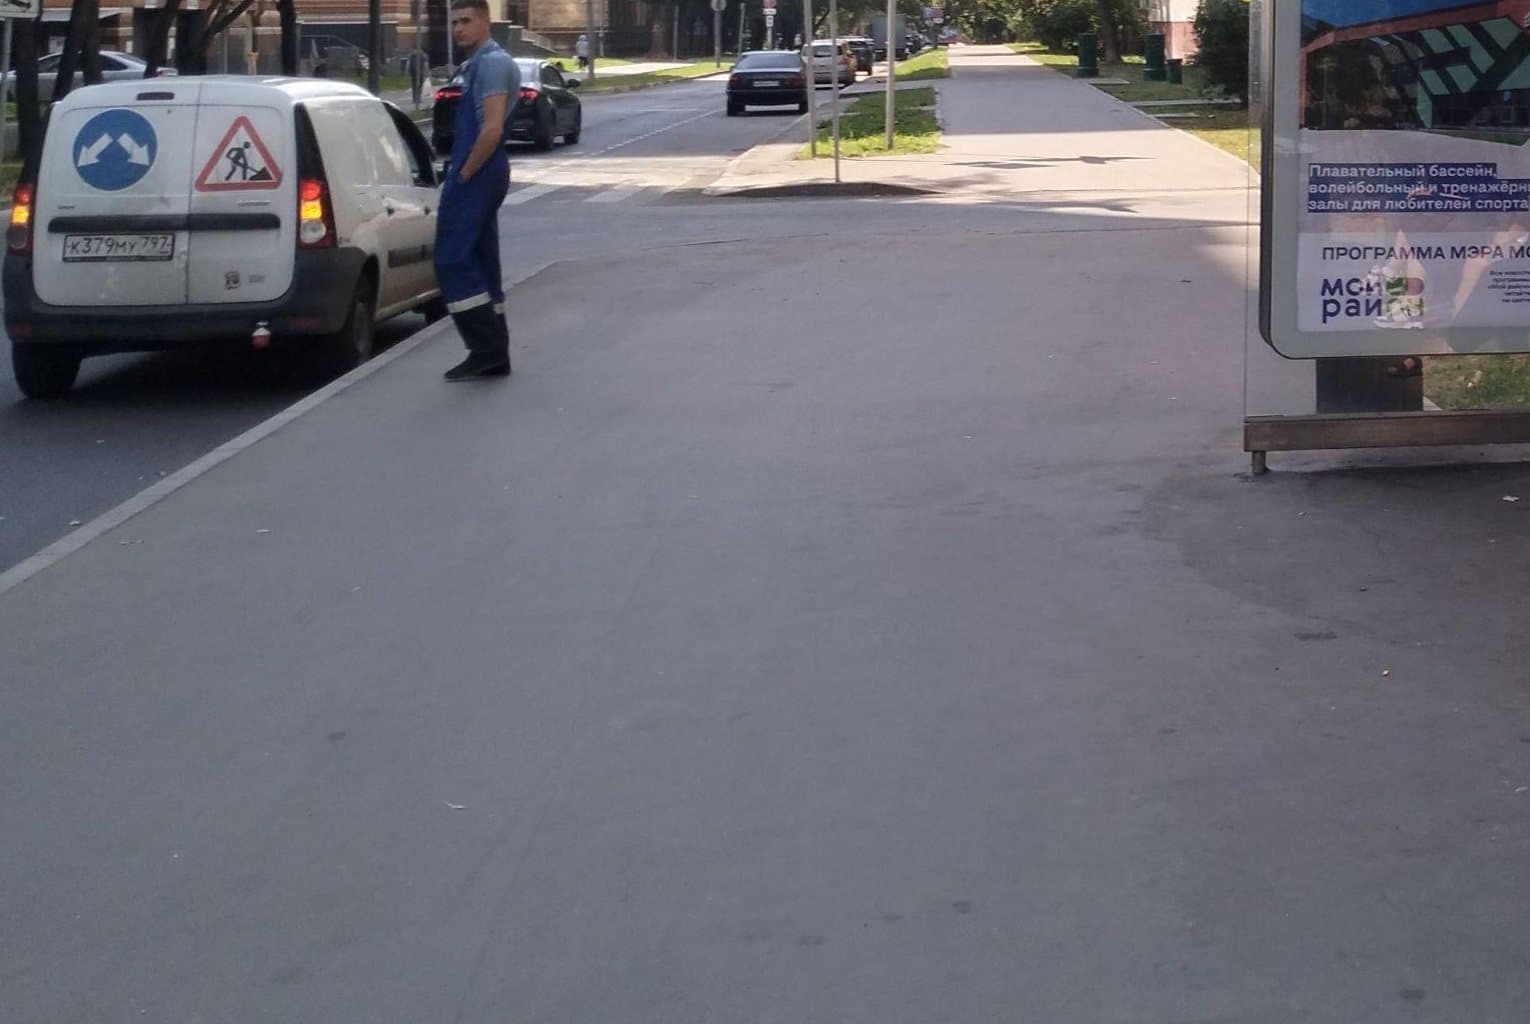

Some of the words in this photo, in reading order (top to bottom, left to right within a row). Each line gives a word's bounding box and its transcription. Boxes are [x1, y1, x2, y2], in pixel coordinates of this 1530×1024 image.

[1310, 165, 1425, 177] Плавательный
[1430, 164, 1497, 178] бассейн,
[1310, 180, 1424, 193] волейбольный
[1430, 184, 1437, 193] и
[1309, 200, 1347, 210] залы
[1353, 200, 1380, 211] для
[1385, 198, 1471, 210] любителей
[1476, 199, 1529, 212] спорта
[140, 236, 169, 250] 797
[1322, 246, 1445, 260] ПРОГРАММА
[1450, 245, 1503, 259] МЭРА
